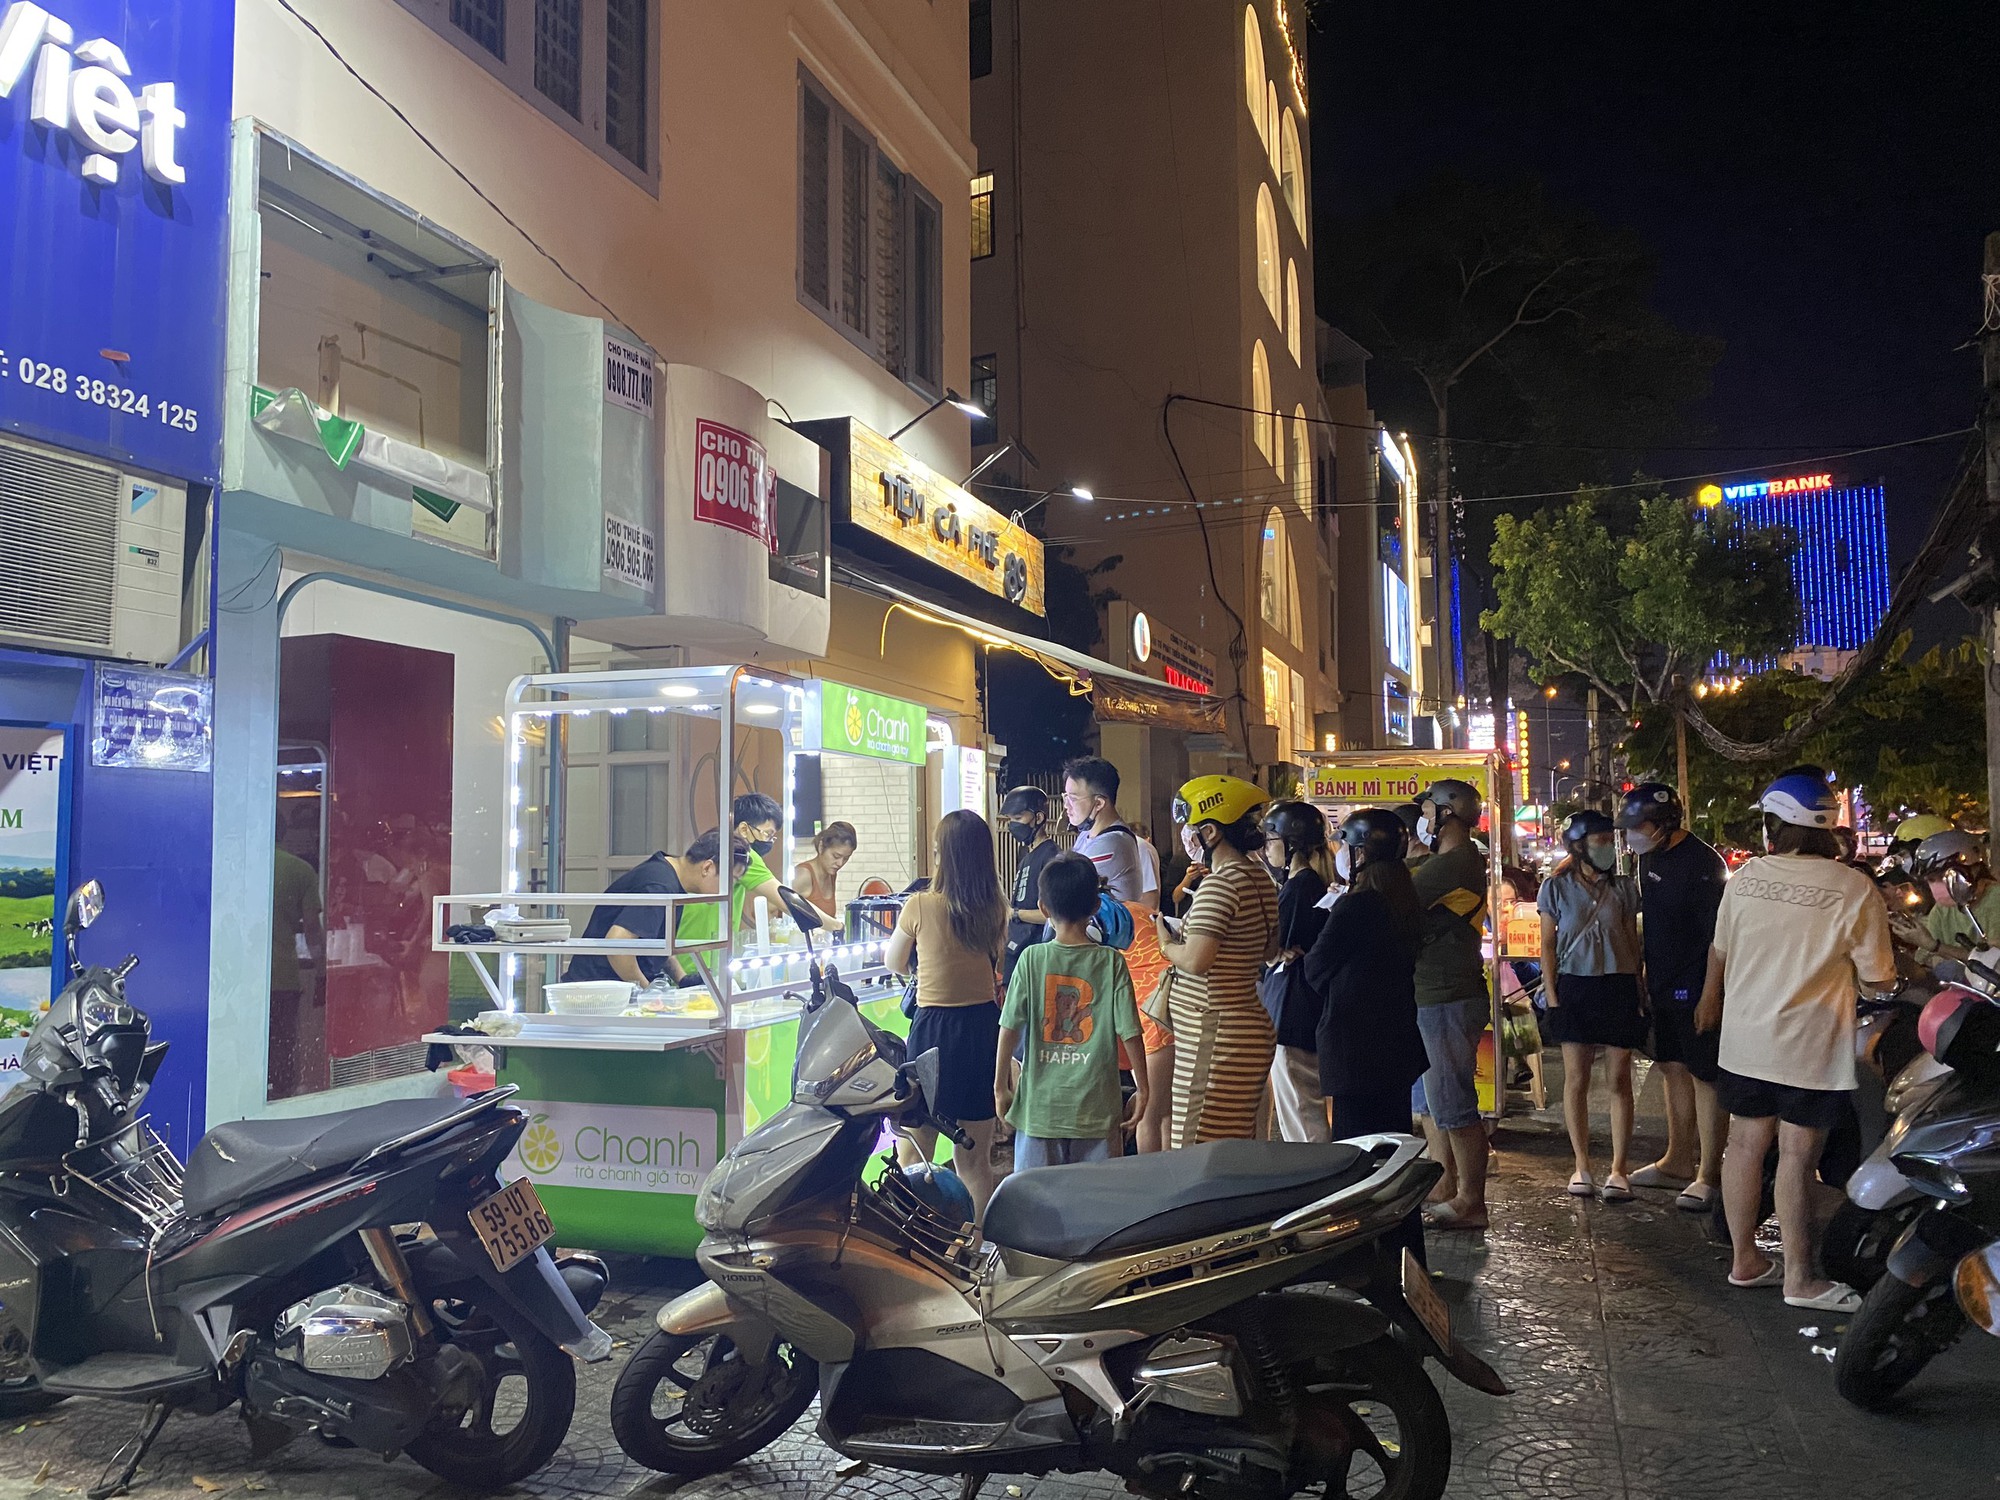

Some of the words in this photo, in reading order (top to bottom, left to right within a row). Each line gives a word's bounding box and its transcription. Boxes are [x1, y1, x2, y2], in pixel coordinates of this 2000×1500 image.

[608, 341, 621, 356] CHO
[19, 357, 67, 394] 028
[75, 375, 150, 418] 38324
[157, 400, 198, 433] 125
[702, 430, 741, 459] CHO
[1724, 474, 1832, 500] VIETBANK
[606, 517, 621, 537] CHO
[879, 471, 925, 528] TIỆM
[933, 502, 963, 547] CÀ
[1003, 552, 1028, 603] 89
[867, 708, 910, 743] Chanh
[2, 751, 59, 775] VIỆT
[1314, 778, 1357, 796] BÁNH
[1363, 777, 1381, 796] MÌ
[1386, 773, 1419, 796] THỔ
[1040, 1050, 1091, 1064] HAPPY
[575, 1126, 700, 1167] Chanh
[574, 1164, 594, 1179] trà
[599, 1165, 641, 1182] chanh
[675, 1170, 699, 1188] tay
[480, 1187, 529, 1233] 59-U1
[490, 1210, 549, 1265] 755.86
[722, 1274, 765, 1283] HONDA
